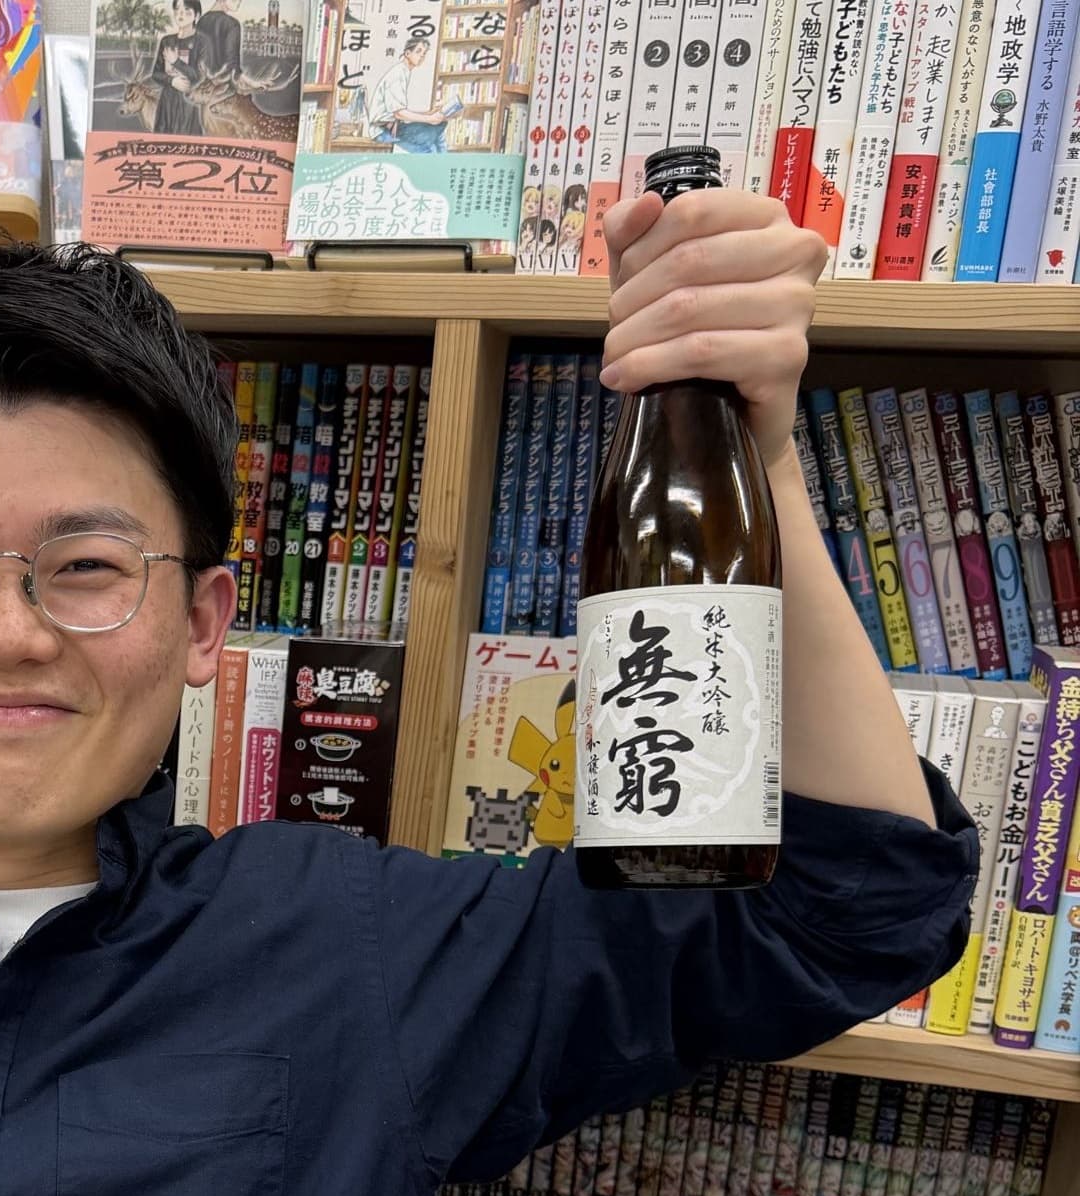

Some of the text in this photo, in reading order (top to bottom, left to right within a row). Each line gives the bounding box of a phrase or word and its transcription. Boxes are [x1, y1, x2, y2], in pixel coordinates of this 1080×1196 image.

[337, 29, 370, 89] ほど
[470, 11, 507, 69] なら
[650, 46, 662, 62] 2
[690, 45, 702, 63] 3
[730, 44, 743, 62] 4
[996, 0, 1027, 85] く地政学
[1040, 0, 1069, 91] 言語学する
[917, 4, 956, 145] か、起業します
[1031, 99, 1050, 152] 水野太貴
[107, 159, 279, 195] 第2位
[818, 148, 840, 212] 新井紀子
[874, 137, 890, 188] 今井むつみ
[295, 192, 321, 234] 場所
[320, 181, 341, 237] ための
[343, 176, 365, 236] 出会う
[364, 163, 387, 236] もう一度
[385, 178, 410, 236] 人とが
[410, 195, 432, 236] 本と
[896, 164, 922, 238] 安野貴博
[243, 539, 256, 553] 18
[285, 540, 299, 555] 20
[307, 542, 321, 556] 21
[331, 541, 339, 555] 1
[354, 542, 364, 556] 2
[374, 543, 385, 557] 3
[402, 543, 415, 560] 4
[848, 537, 873, 595] 4
[873, 537, 900, 597] 5
[904, 541, 931, 598] 6
[931, 540, 953, 600] 7
[963, 543, 989, 600] 8
[992, 543, 1020, 602] 9
[252, 656, 287, 669] WHAT
[261, 670, 277, 681] IF?
[314, 667, 377, 701] 臭豆腐
[702, 605, 732, 735] 純米大吟醸
[601, 610, 698, 817] 無窮
[1025, 675, 1080, 902] 金持ち父さん貧乏父さん
[1017, 918, 1047, 1013] ロバート・キヨサキ
[827, 1135, 847, 1159] 19
[848, 1141, 869, 1162] 20
[1021, 1168, 1043, 1193] 27
